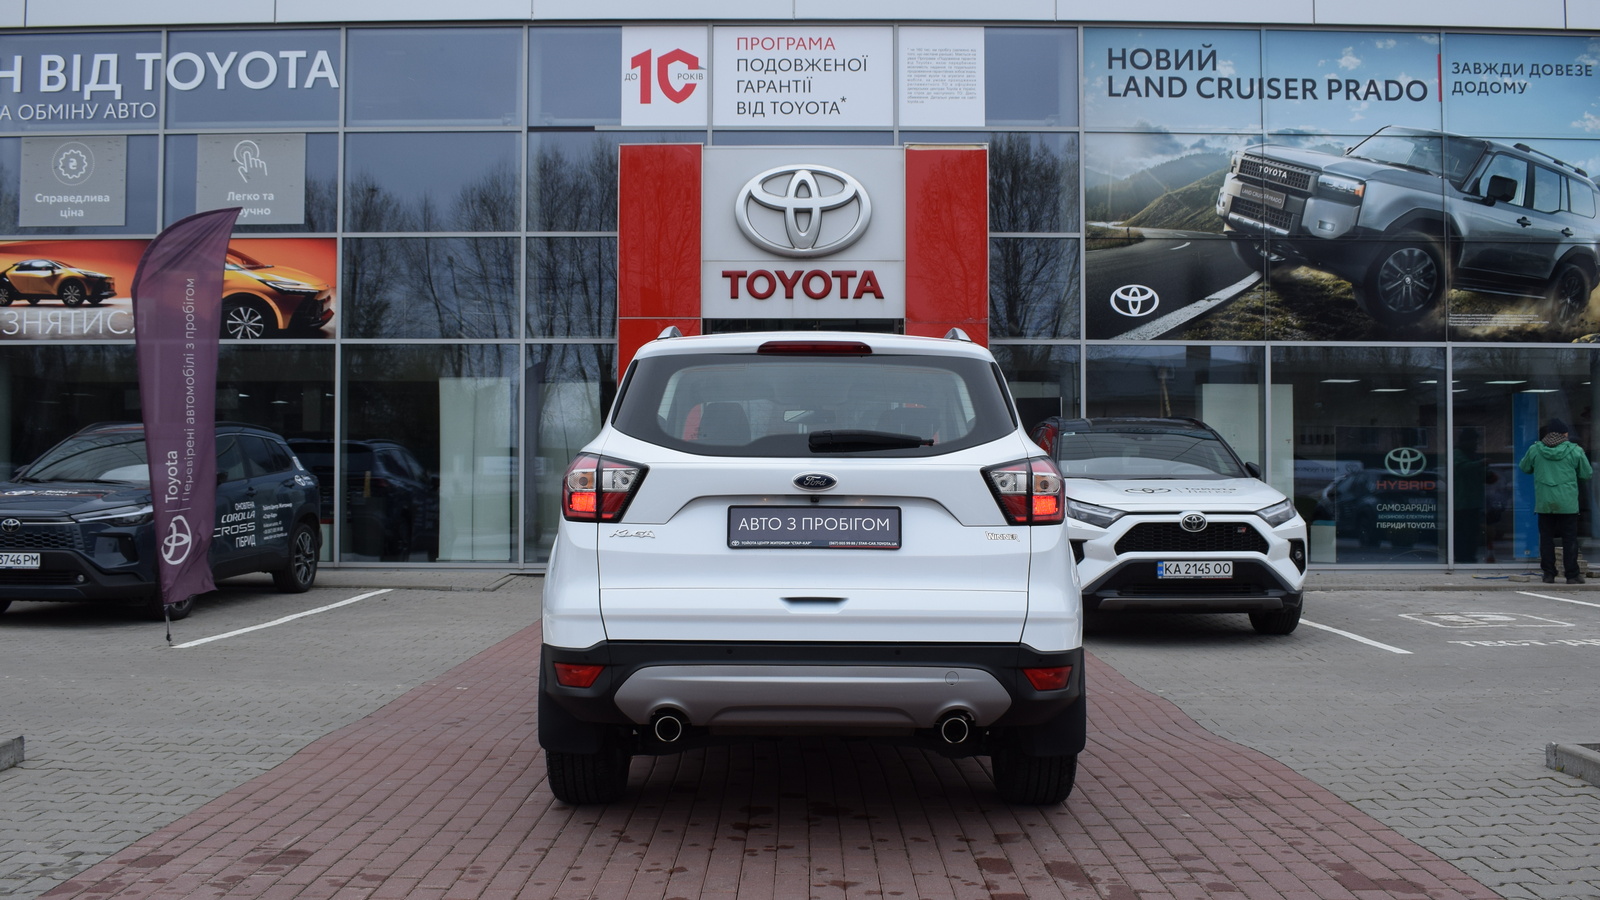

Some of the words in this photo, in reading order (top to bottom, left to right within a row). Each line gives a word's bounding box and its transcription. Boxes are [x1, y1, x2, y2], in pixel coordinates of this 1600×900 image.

[736, 37, 836, 51] ПРОГРАМА
[736, 55, 868, 73] ПОДОВЖЕНОЇ
[1107, 44, 1218, 72] НОВИЙ
[40, 54, 122, 100] ВІД
[136, 50, 340, 91] TOYOTA
[625, 73, 638, 82] ДО
[677, 72, 704, 81] РОКІВ
[1451, 62, 1525, 78] ЗАВЖДИ
[1529, 63, 1593, 79] ДОВЕЗЕ
[736, 77, 812, 94] ГАРАНТІЇ
[1107, 75, 1188, 99] LAND
[1196, 77, 1319, 101] CRUISER
[1327, 79, 1429, 103] PRADO
[1451, 81, 1529, 96] ДОДОМУ
[17, 103, 98, 120] ОБМІНУ
[103, 102, 157, 119] АВТО
[736, 101, 766, 117] ВІД
[1259, 165, 1287, 178] TOYOTA
[35, 193, 110, 204] Справедлива
[227, 191, 260, 201] Легко
[262, 193, 275, 201] та
[60, 207, 84, 218] ціна
[721, 269, 885, 300] TOYOTA
[183, 278, 197, 338] пробігом
[183, 353, 196, 424] автомобілі
[165, 450, 181, 503] Toyota
[803, 475, 827, 487] Ford
[1376, 480, 1436, 490] HYBRID
[1376, 503, 1436, 512] САМОЗАРЯДНІ
[222, 511, 255, 523] COROLLA
[738, 517, 782, 531] АВТО
[802, 517, 890, 532] ПРОБІГОМ
[23, 554, 39, 565] PM
[1164, 563, 1182, 575] KA
[1184, 563, 1211, 575] 2145
